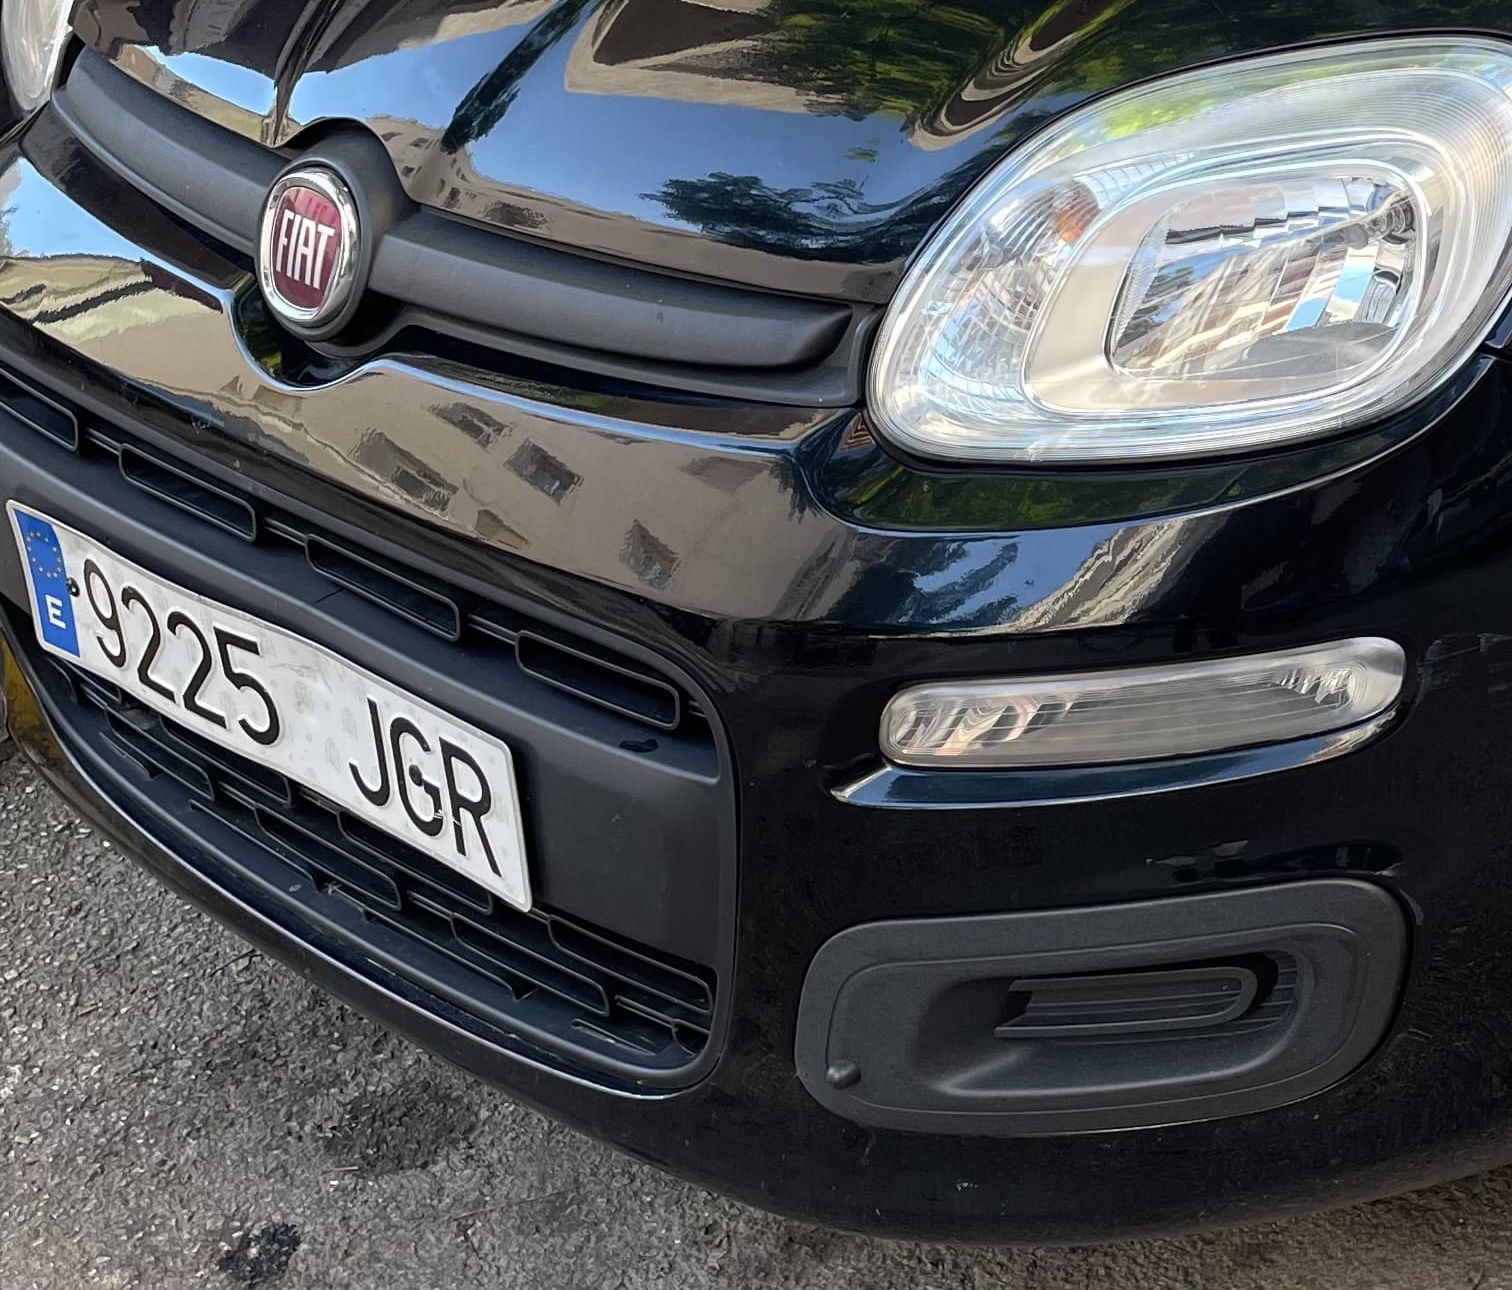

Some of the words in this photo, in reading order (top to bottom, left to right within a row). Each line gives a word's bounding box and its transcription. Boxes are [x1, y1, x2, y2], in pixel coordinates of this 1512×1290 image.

[276, 210, 335, 290] FIAT
[46, 594, 66, 629] E
[83, 559, 280, 746] 9225
[349, 697, 502, 878] JGR
